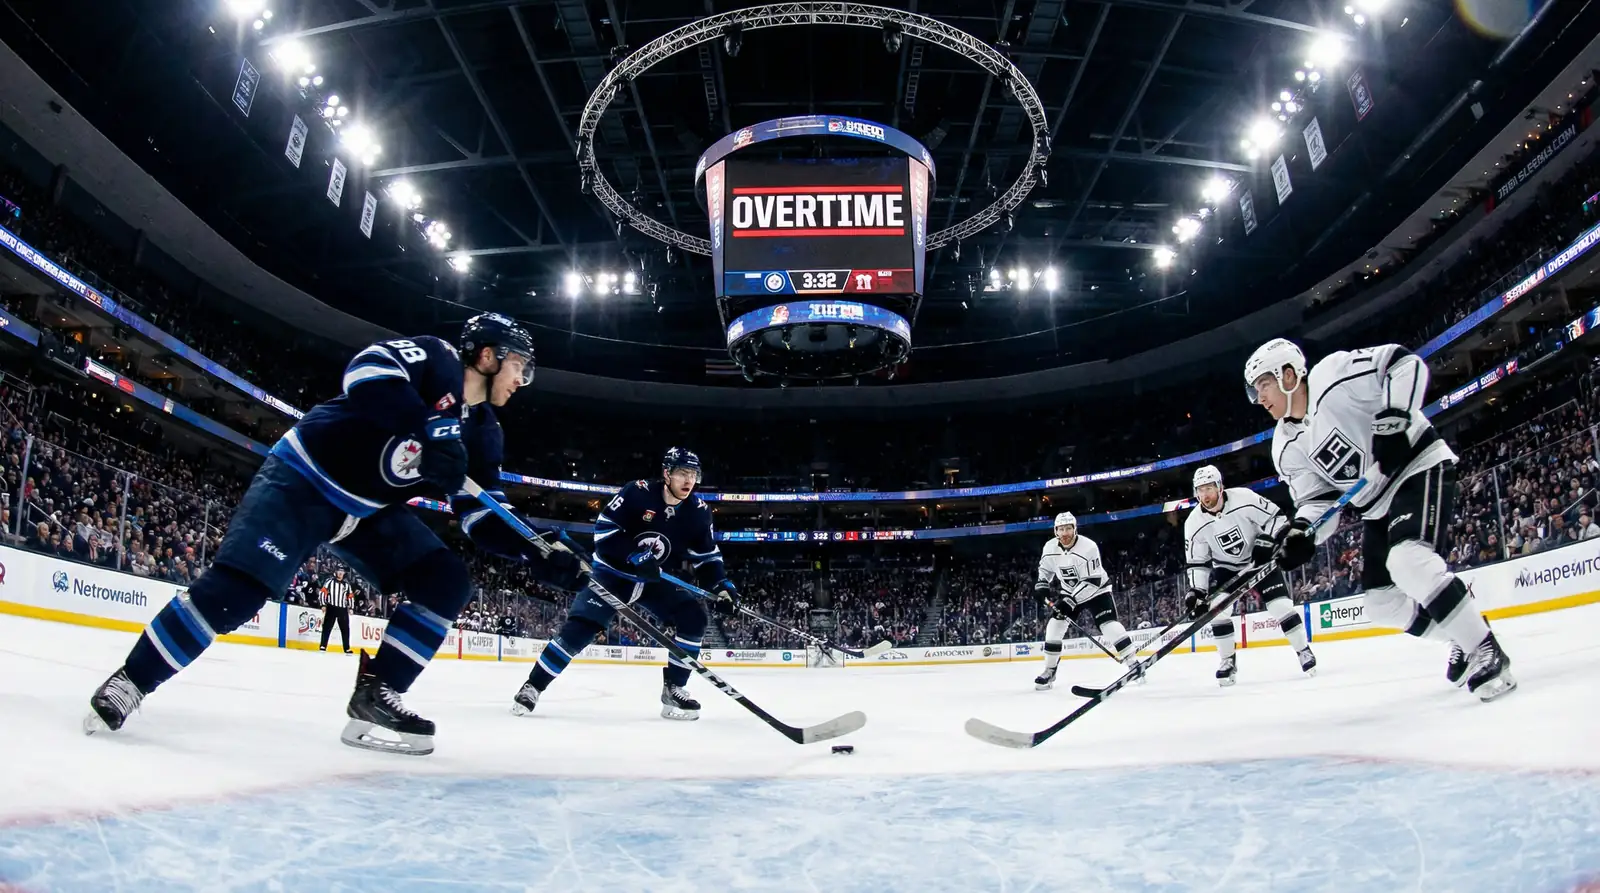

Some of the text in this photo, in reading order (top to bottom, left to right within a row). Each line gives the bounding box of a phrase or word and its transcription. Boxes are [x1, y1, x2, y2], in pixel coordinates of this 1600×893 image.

[732, 194, 905, 229] OVERTIME
[803, 272, 837, 289] 3:32
[1321, 605, 1364, 621] enterpr
